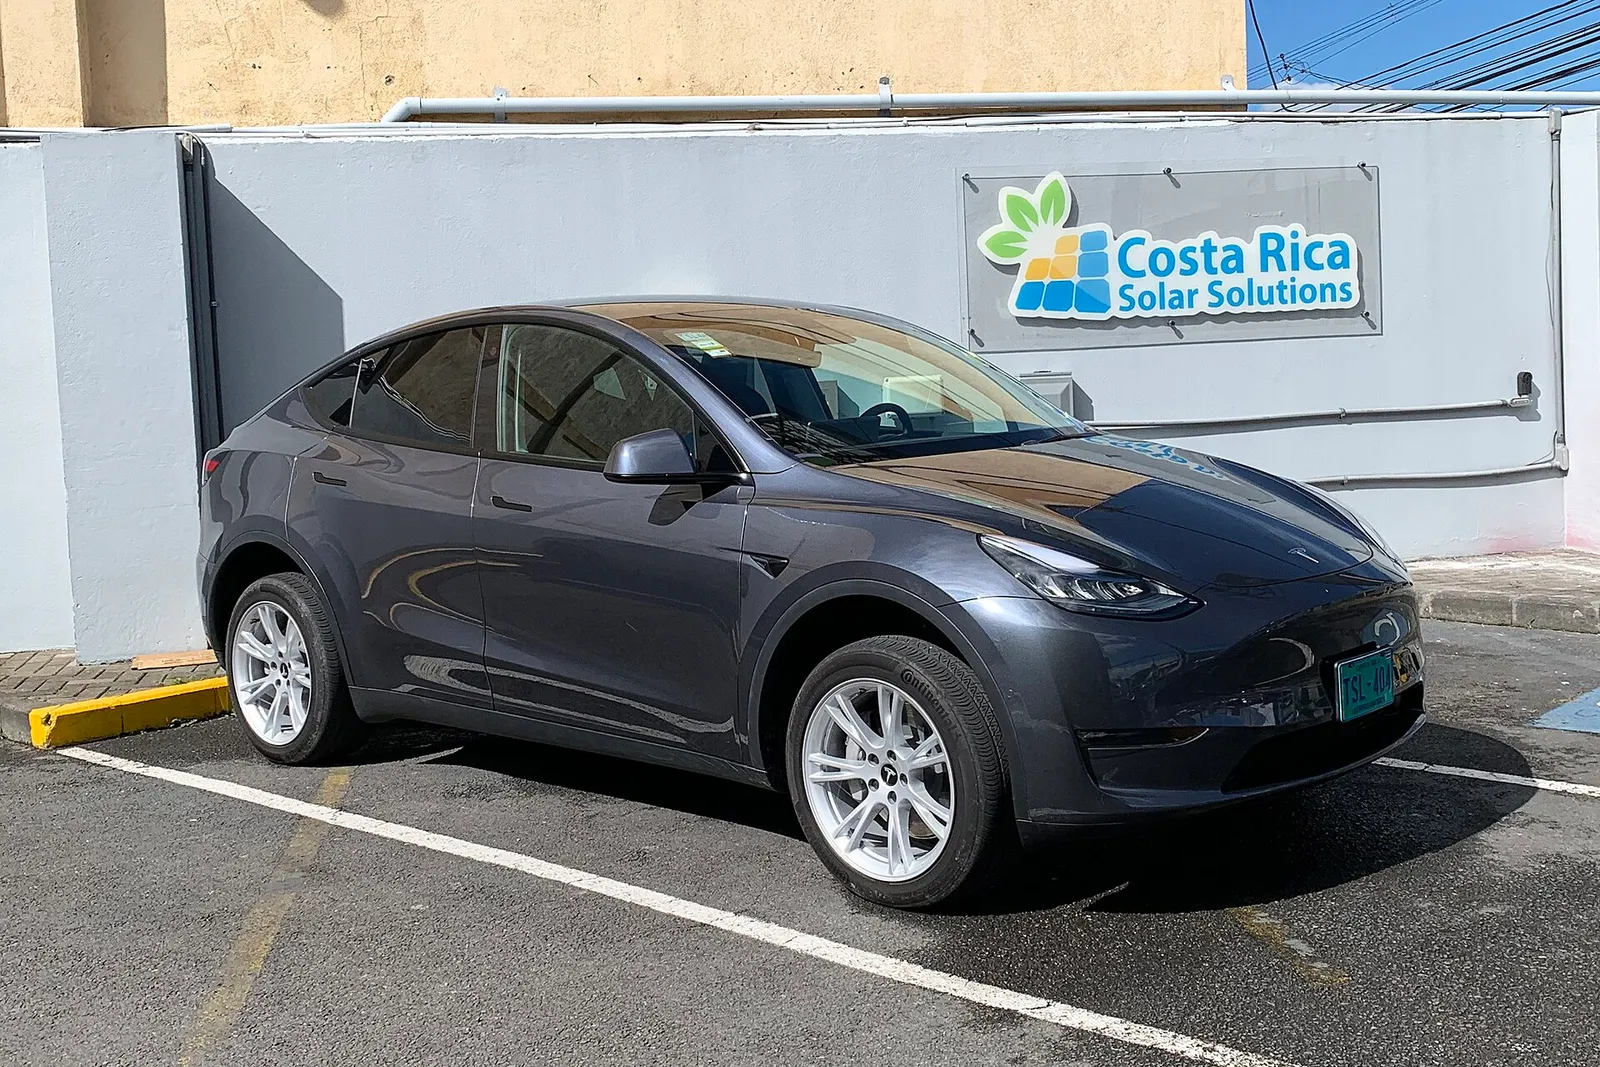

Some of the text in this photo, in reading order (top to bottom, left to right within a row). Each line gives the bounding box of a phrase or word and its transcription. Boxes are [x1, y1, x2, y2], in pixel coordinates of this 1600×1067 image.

[1118, 230, 1351, 278] Costa Rica
[1118, 277, 1353, 313] Solar Solutions
[900, 668, 958, 732] Continental
